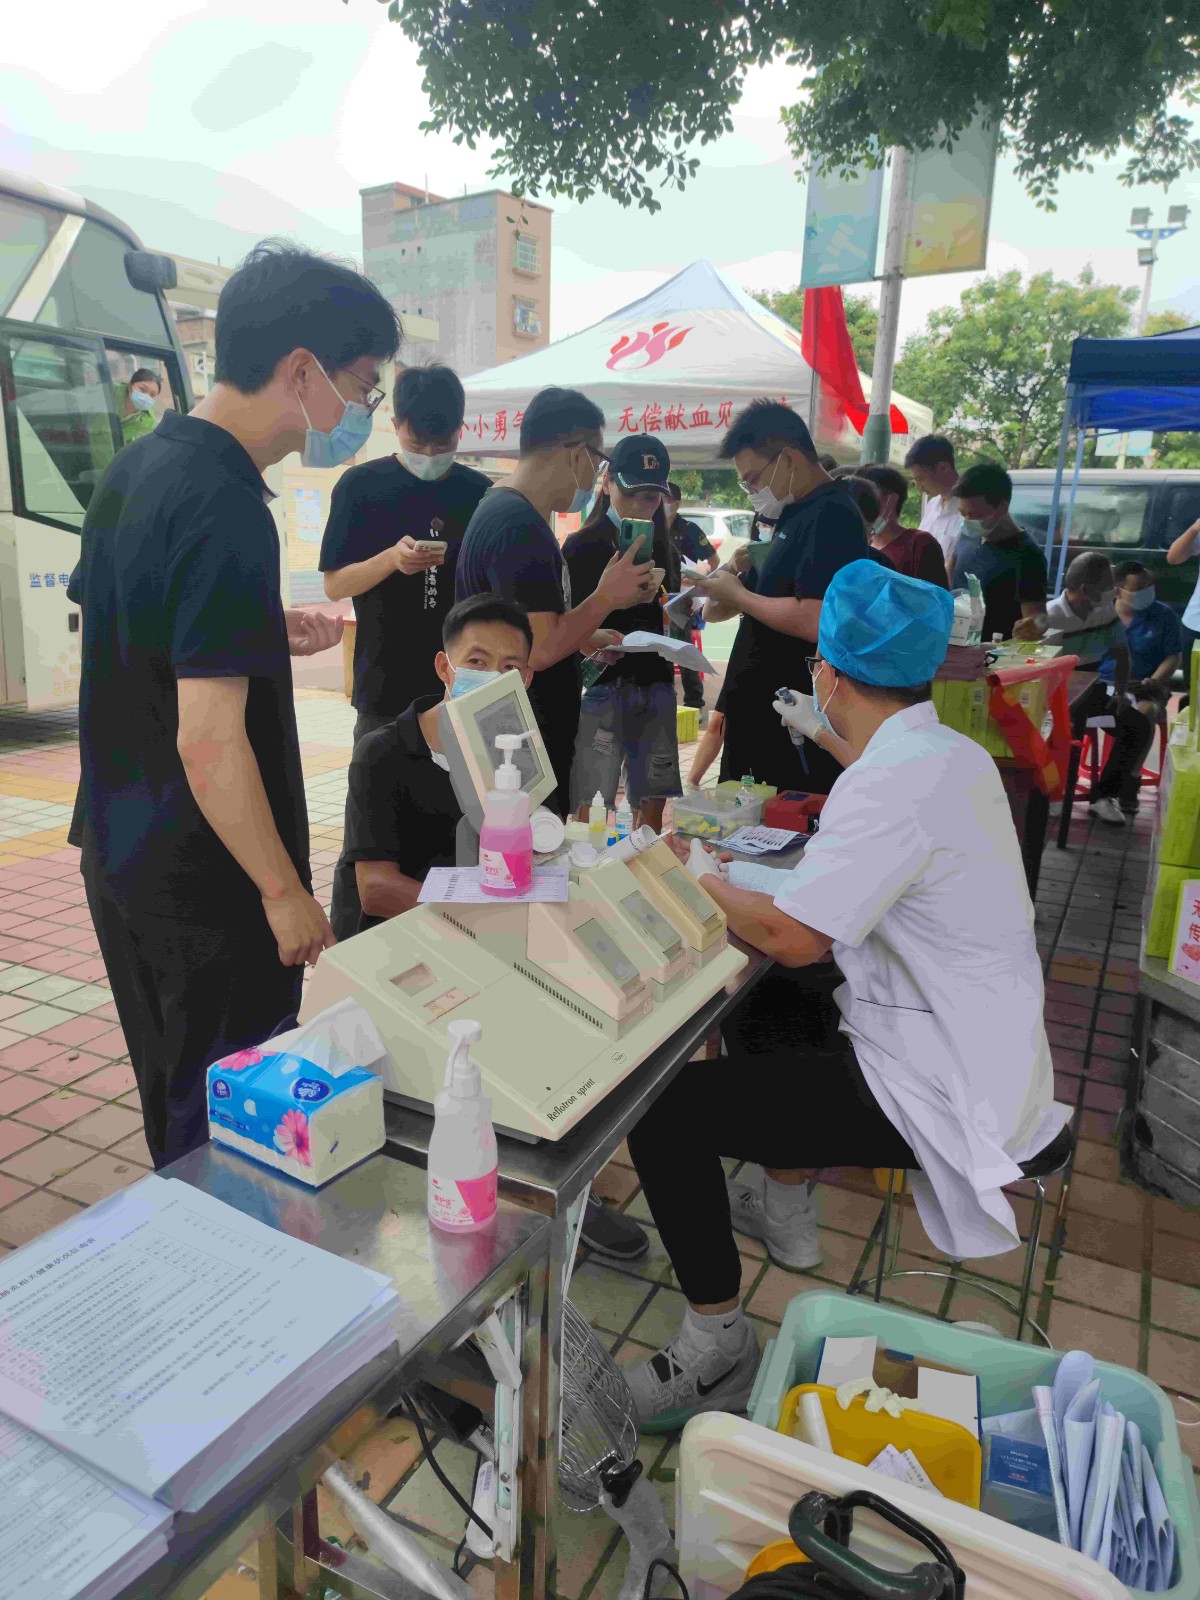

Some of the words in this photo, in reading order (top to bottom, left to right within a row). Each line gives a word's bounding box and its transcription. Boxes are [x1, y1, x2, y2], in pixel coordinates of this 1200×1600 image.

[618, 396, 792, 432] 无偿献血见
[546, 1095, 578, 1122] Reflotron
[576, 1078, 596, 1097] sprint
